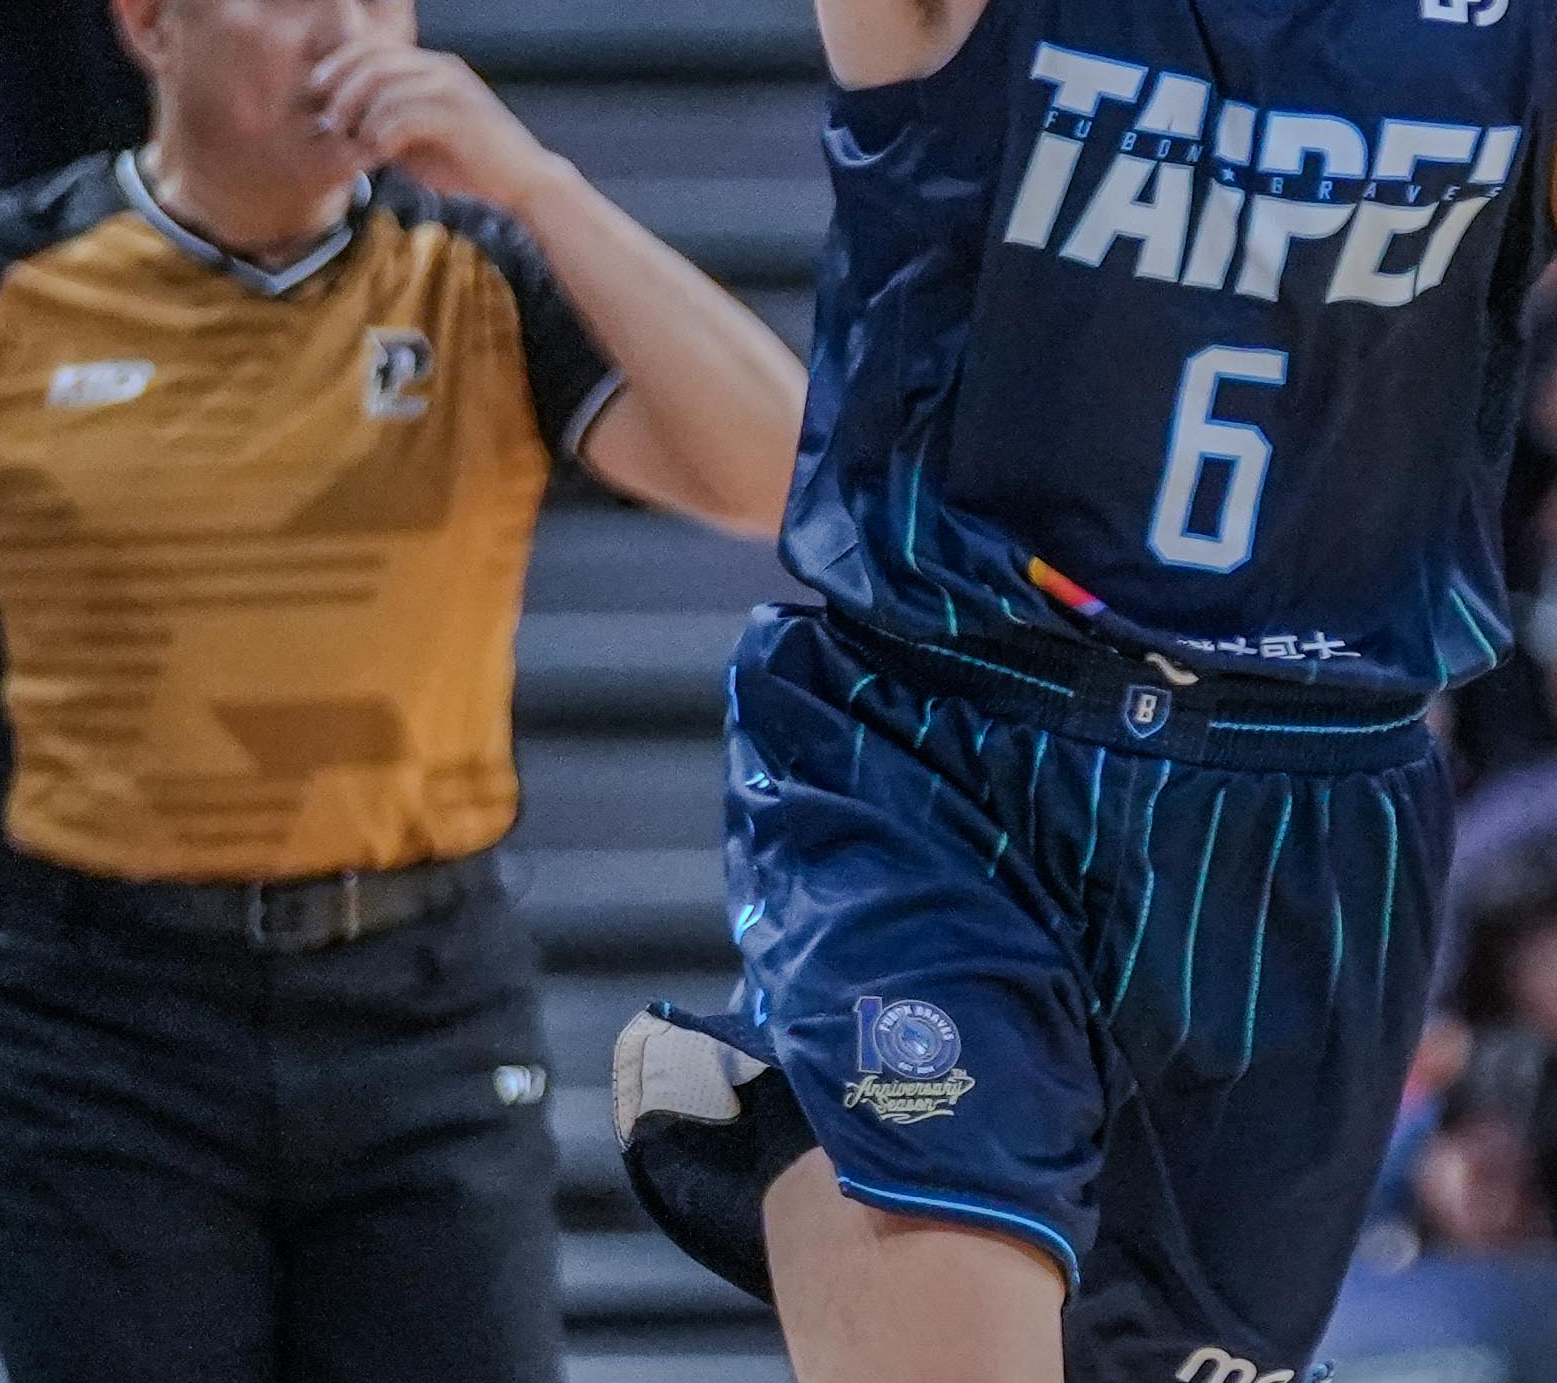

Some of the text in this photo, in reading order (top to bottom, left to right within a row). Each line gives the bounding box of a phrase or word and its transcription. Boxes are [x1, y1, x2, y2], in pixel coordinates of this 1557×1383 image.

[1002, 41, 1522, 307] TAIPEI
[1146, 344, 1290, 574] 6
[844, 1075, 976, 1108] Anniversary
